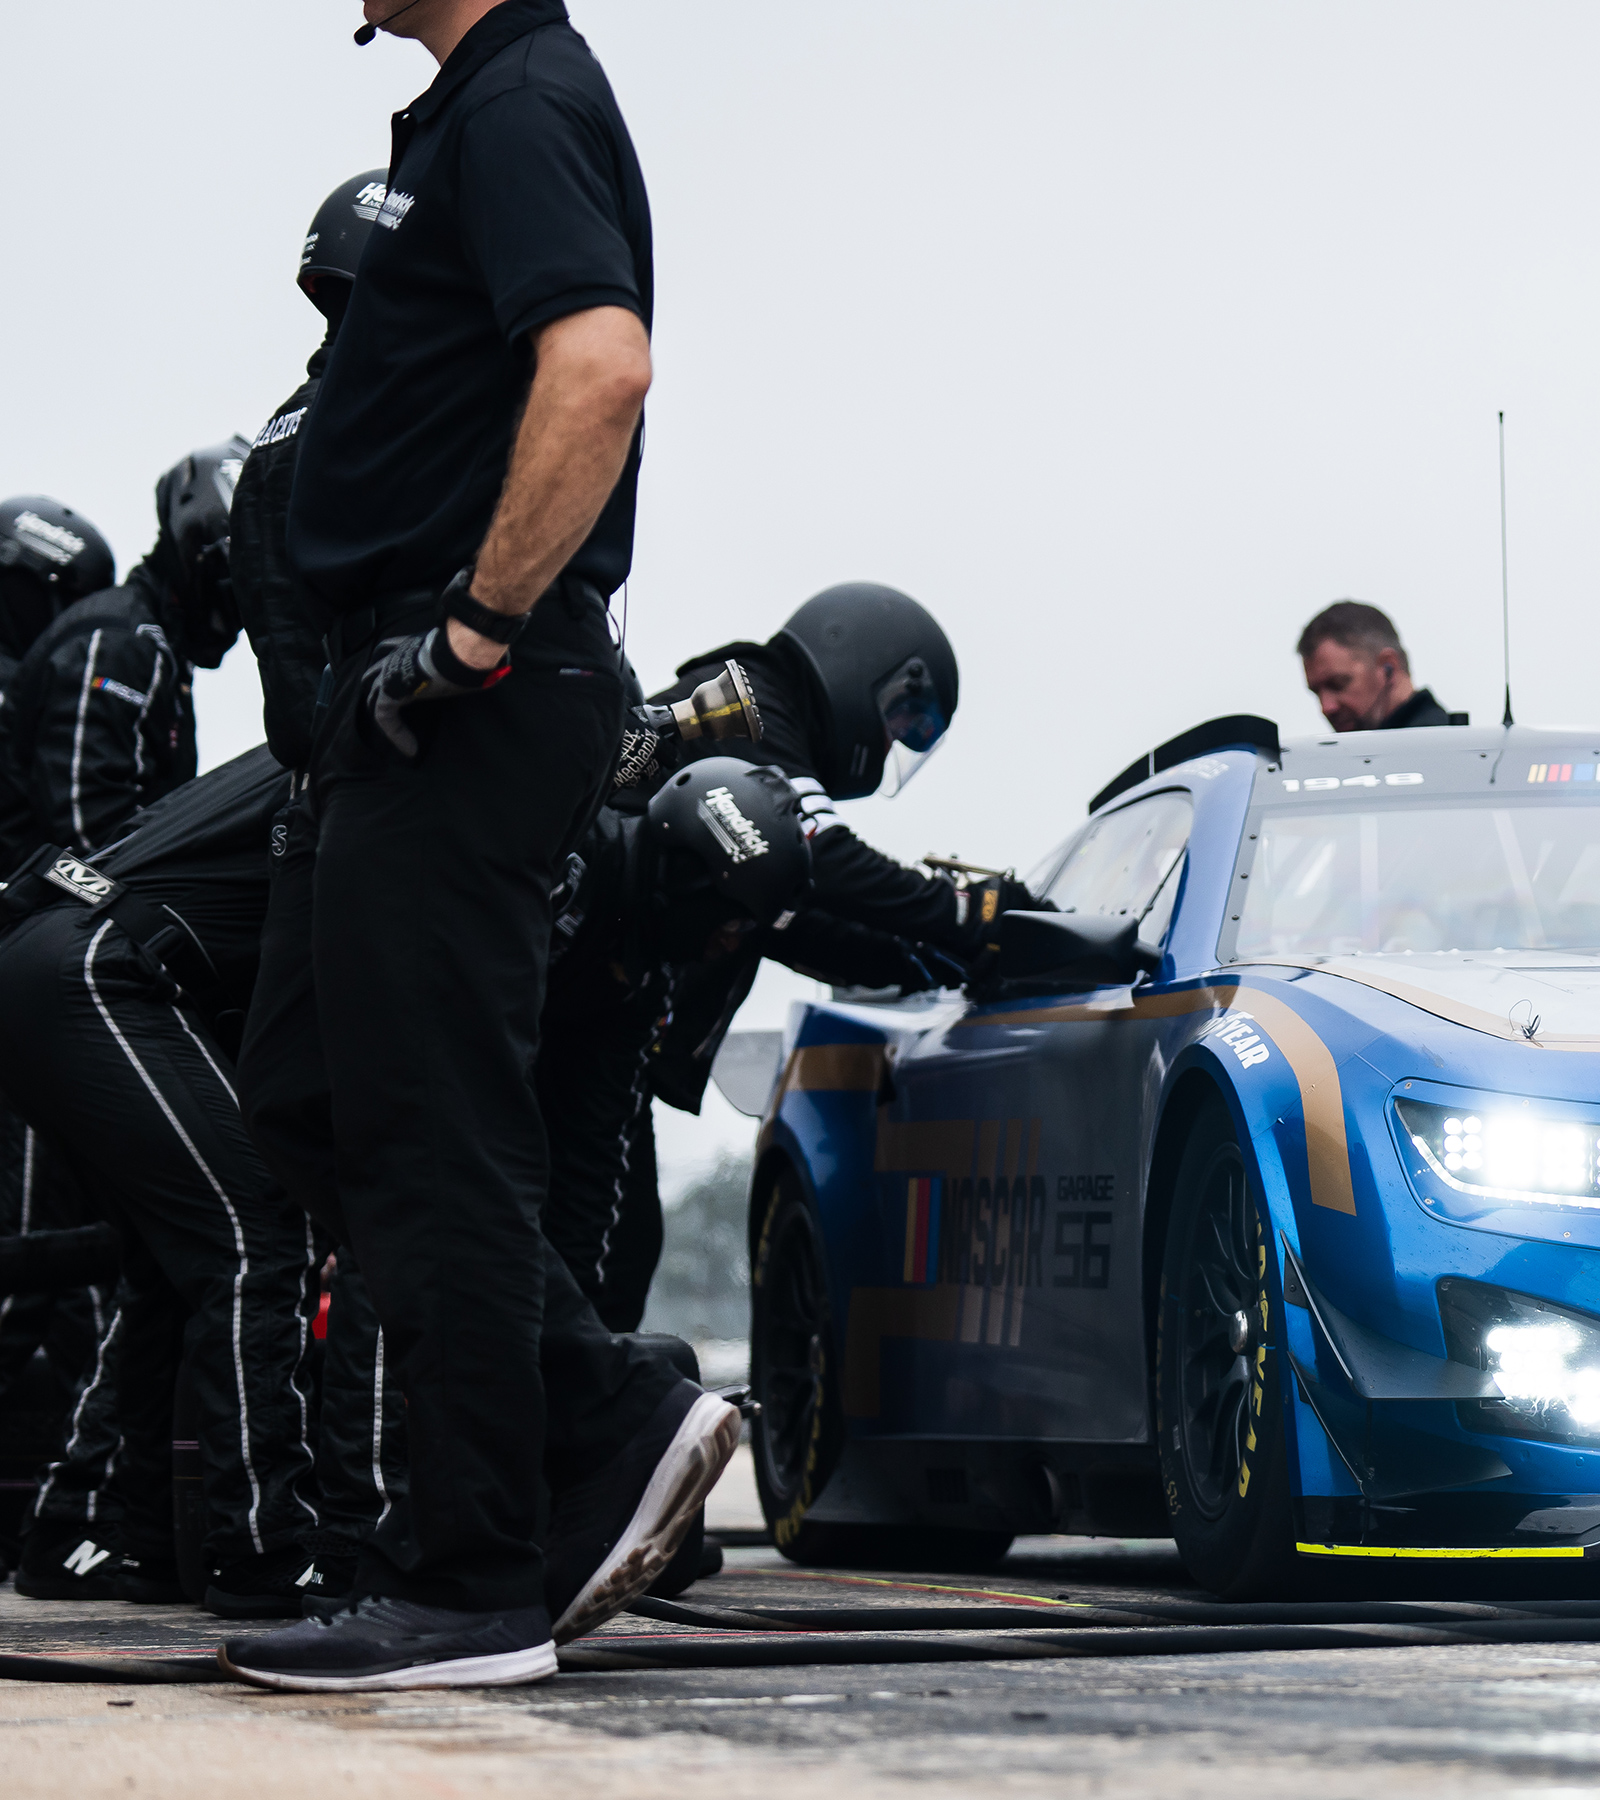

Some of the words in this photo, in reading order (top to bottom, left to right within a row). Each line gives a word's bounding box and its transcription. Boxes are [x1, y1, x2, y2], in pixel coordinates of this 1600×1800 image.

[1281, 772, 1425, 793] 1948
[705, 786, 769, 856] Hendrick
[1056, 1174, 1115, 1202] GARAGE
[937, 1174, 1046, 1288] NASCAR
[1053, 1210, 1113, 1290] 56
